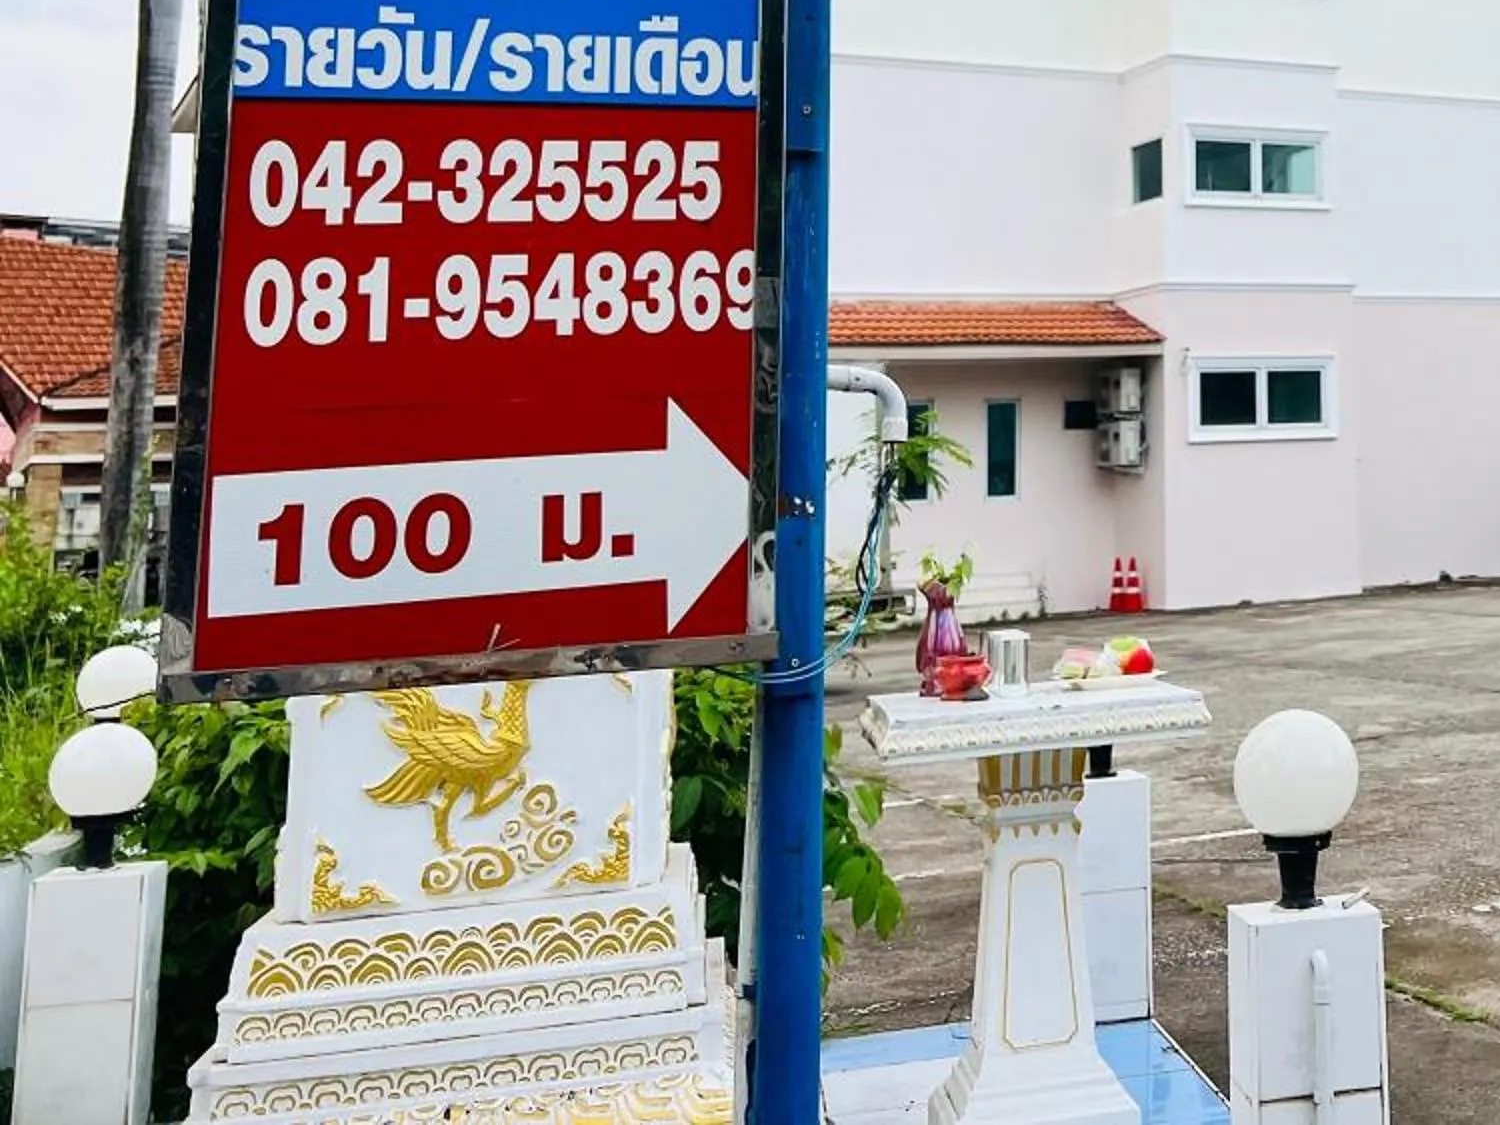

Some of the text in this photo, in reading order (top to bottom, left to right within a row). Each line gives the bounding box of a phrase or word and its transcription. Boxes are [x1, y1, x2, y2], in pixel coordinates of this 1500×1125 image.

[249, 139, 721, 228] 042-325525
[243, 249, 755, 347] 081-9548369
[258, 492, 635, 586] 100 ม.
